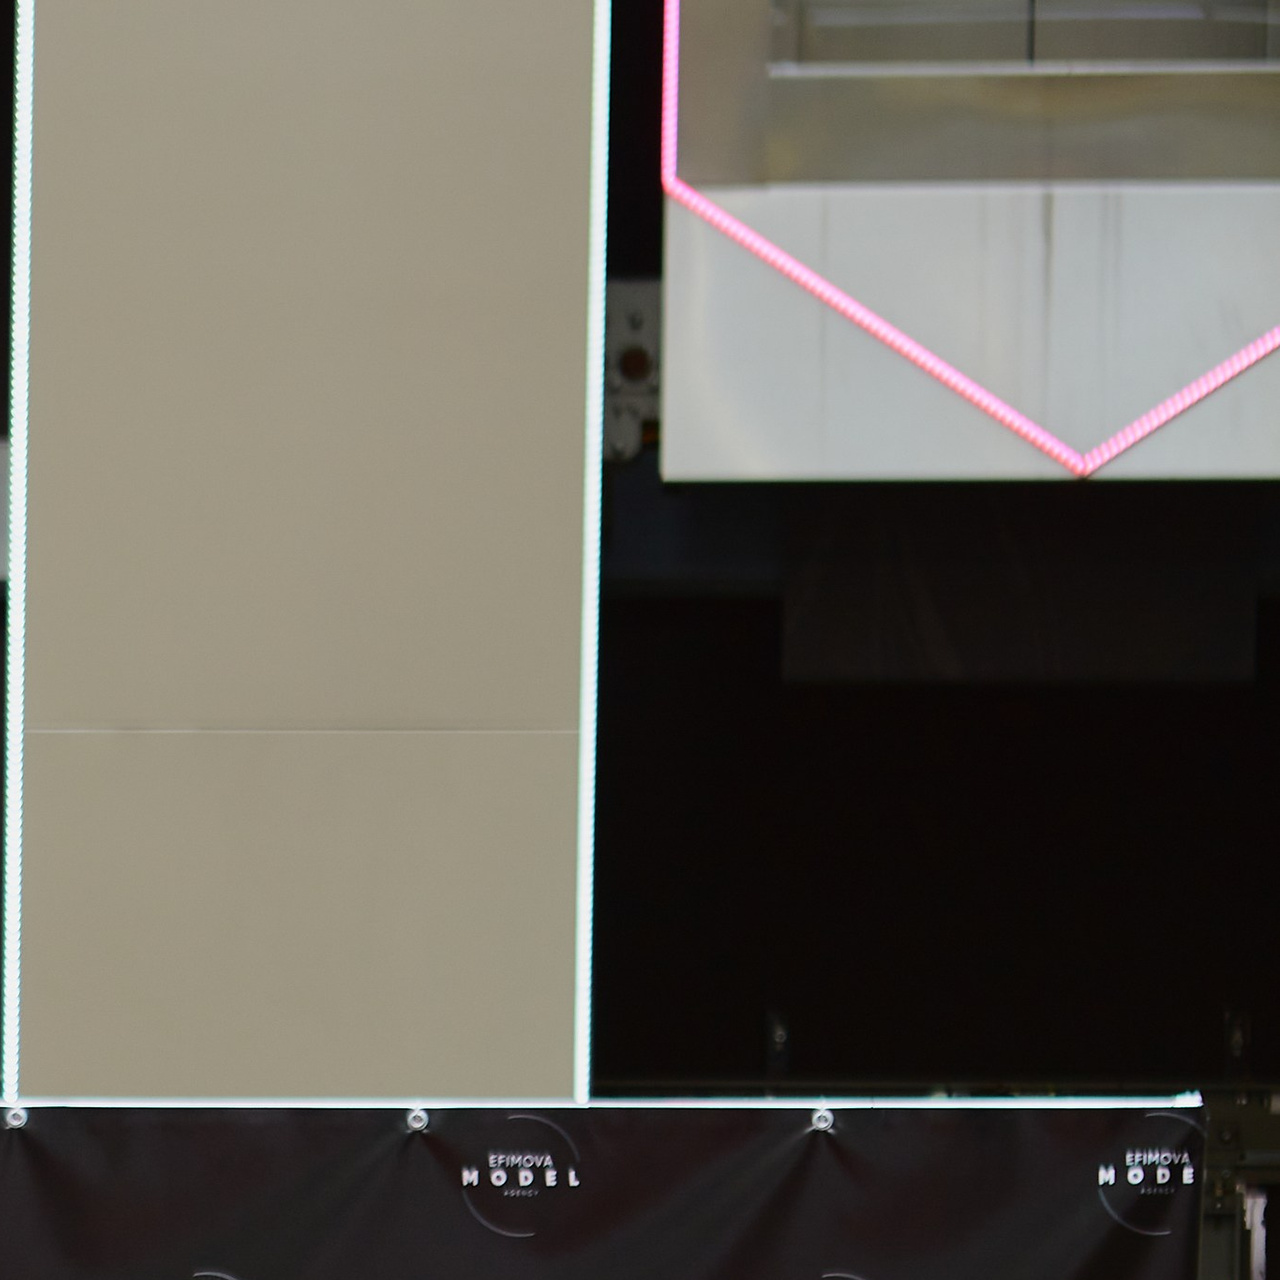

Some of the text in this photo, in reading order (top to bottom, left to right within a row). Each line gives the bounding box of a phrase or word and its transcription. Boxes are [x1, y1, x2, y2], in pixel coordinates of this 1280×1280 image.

[488, 1154, 553, 1168] EFIMOVA
[1125, 1151, 1188, 1165] EFIMOVA
[462, 1168, 580, 1187] MODEL
